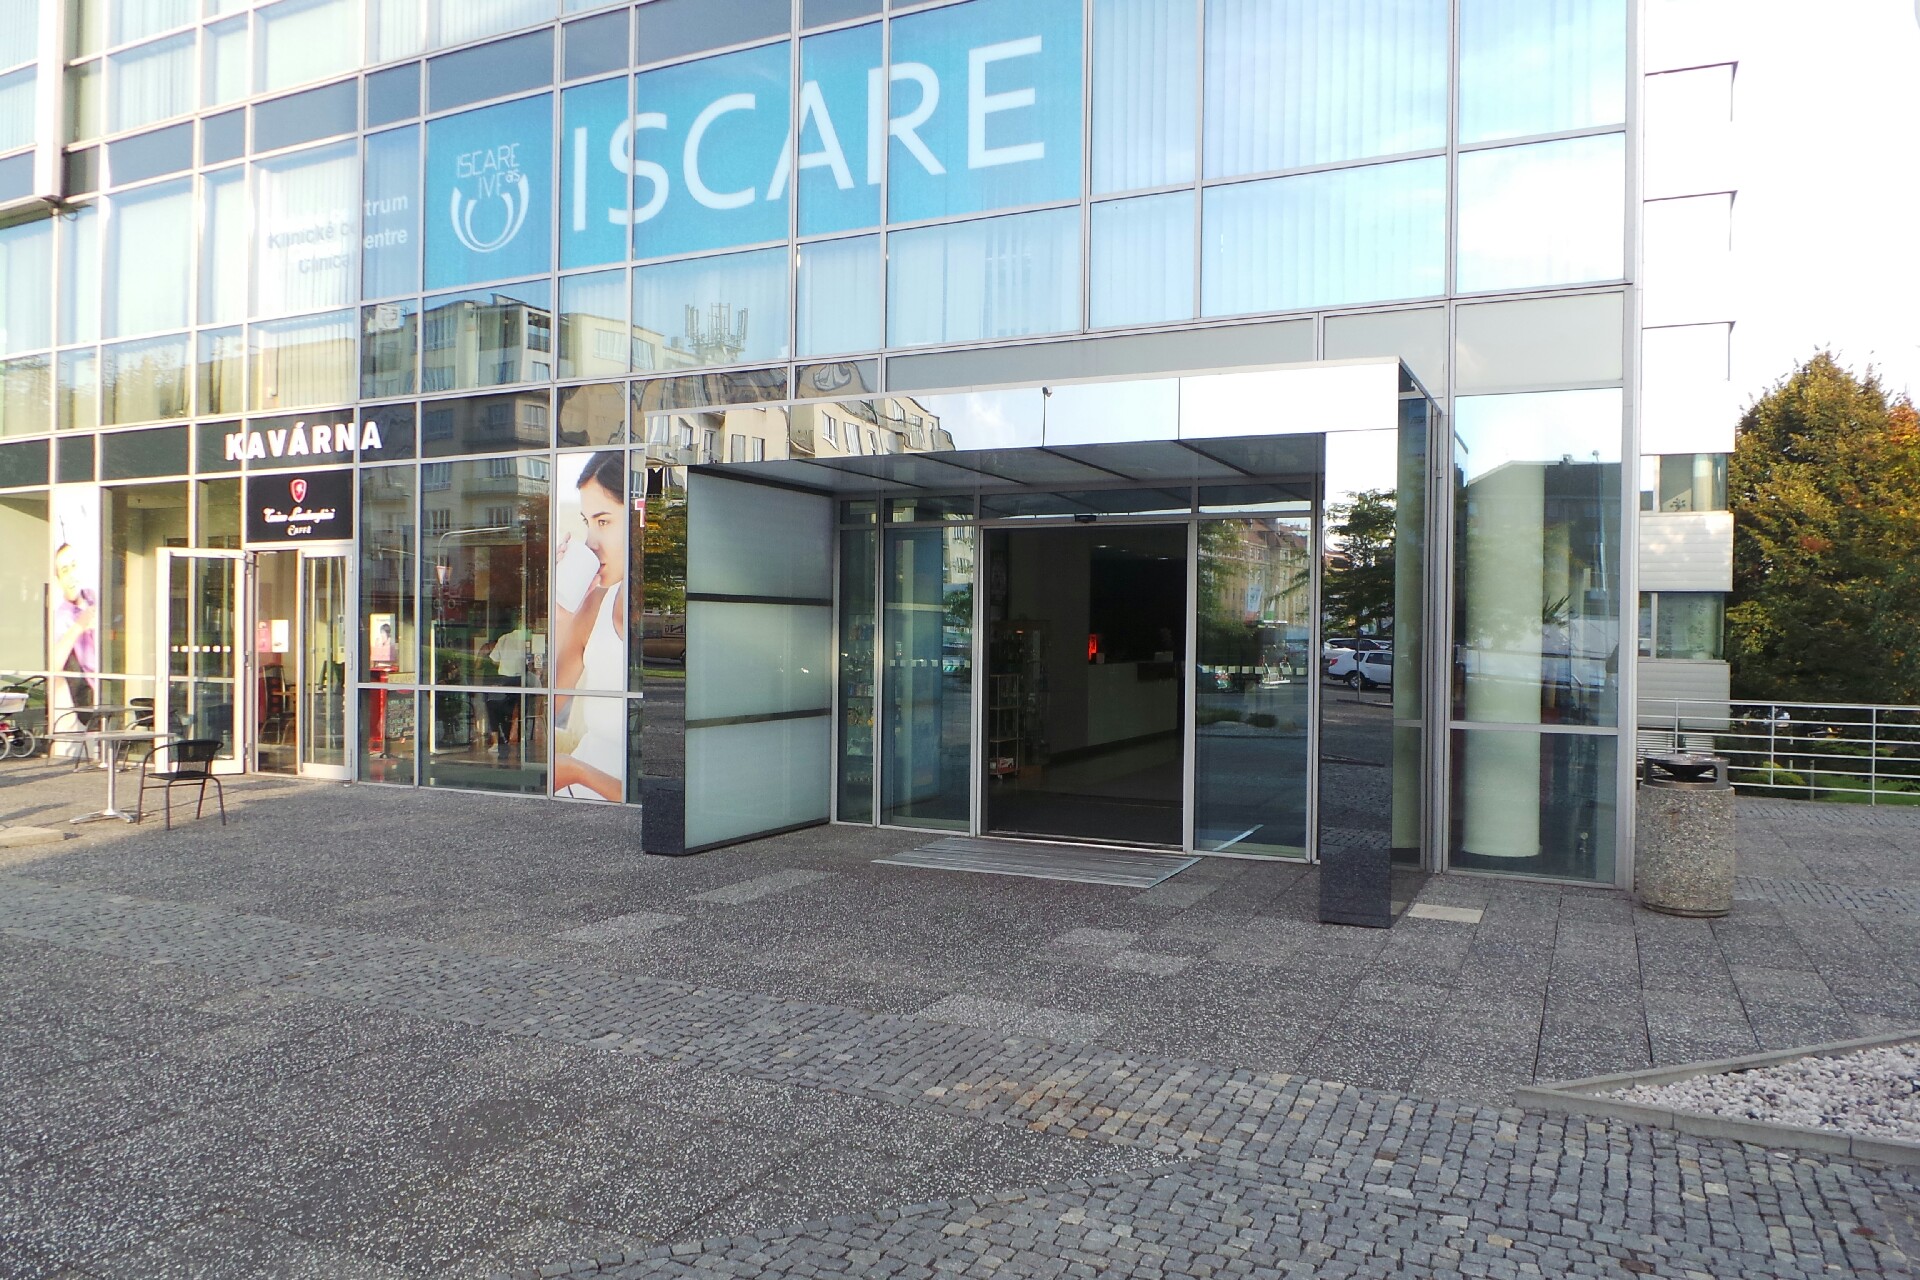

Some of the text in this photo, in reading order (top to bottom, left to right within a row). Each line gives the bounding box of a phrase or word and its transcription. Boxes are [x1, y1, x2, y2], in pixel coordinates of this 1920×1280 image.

[573, 35, 1045, 231] ISCARE
[456, 142, 521, 179] ISCARE
[225, 421, 383, 461] KAVÁRNA
